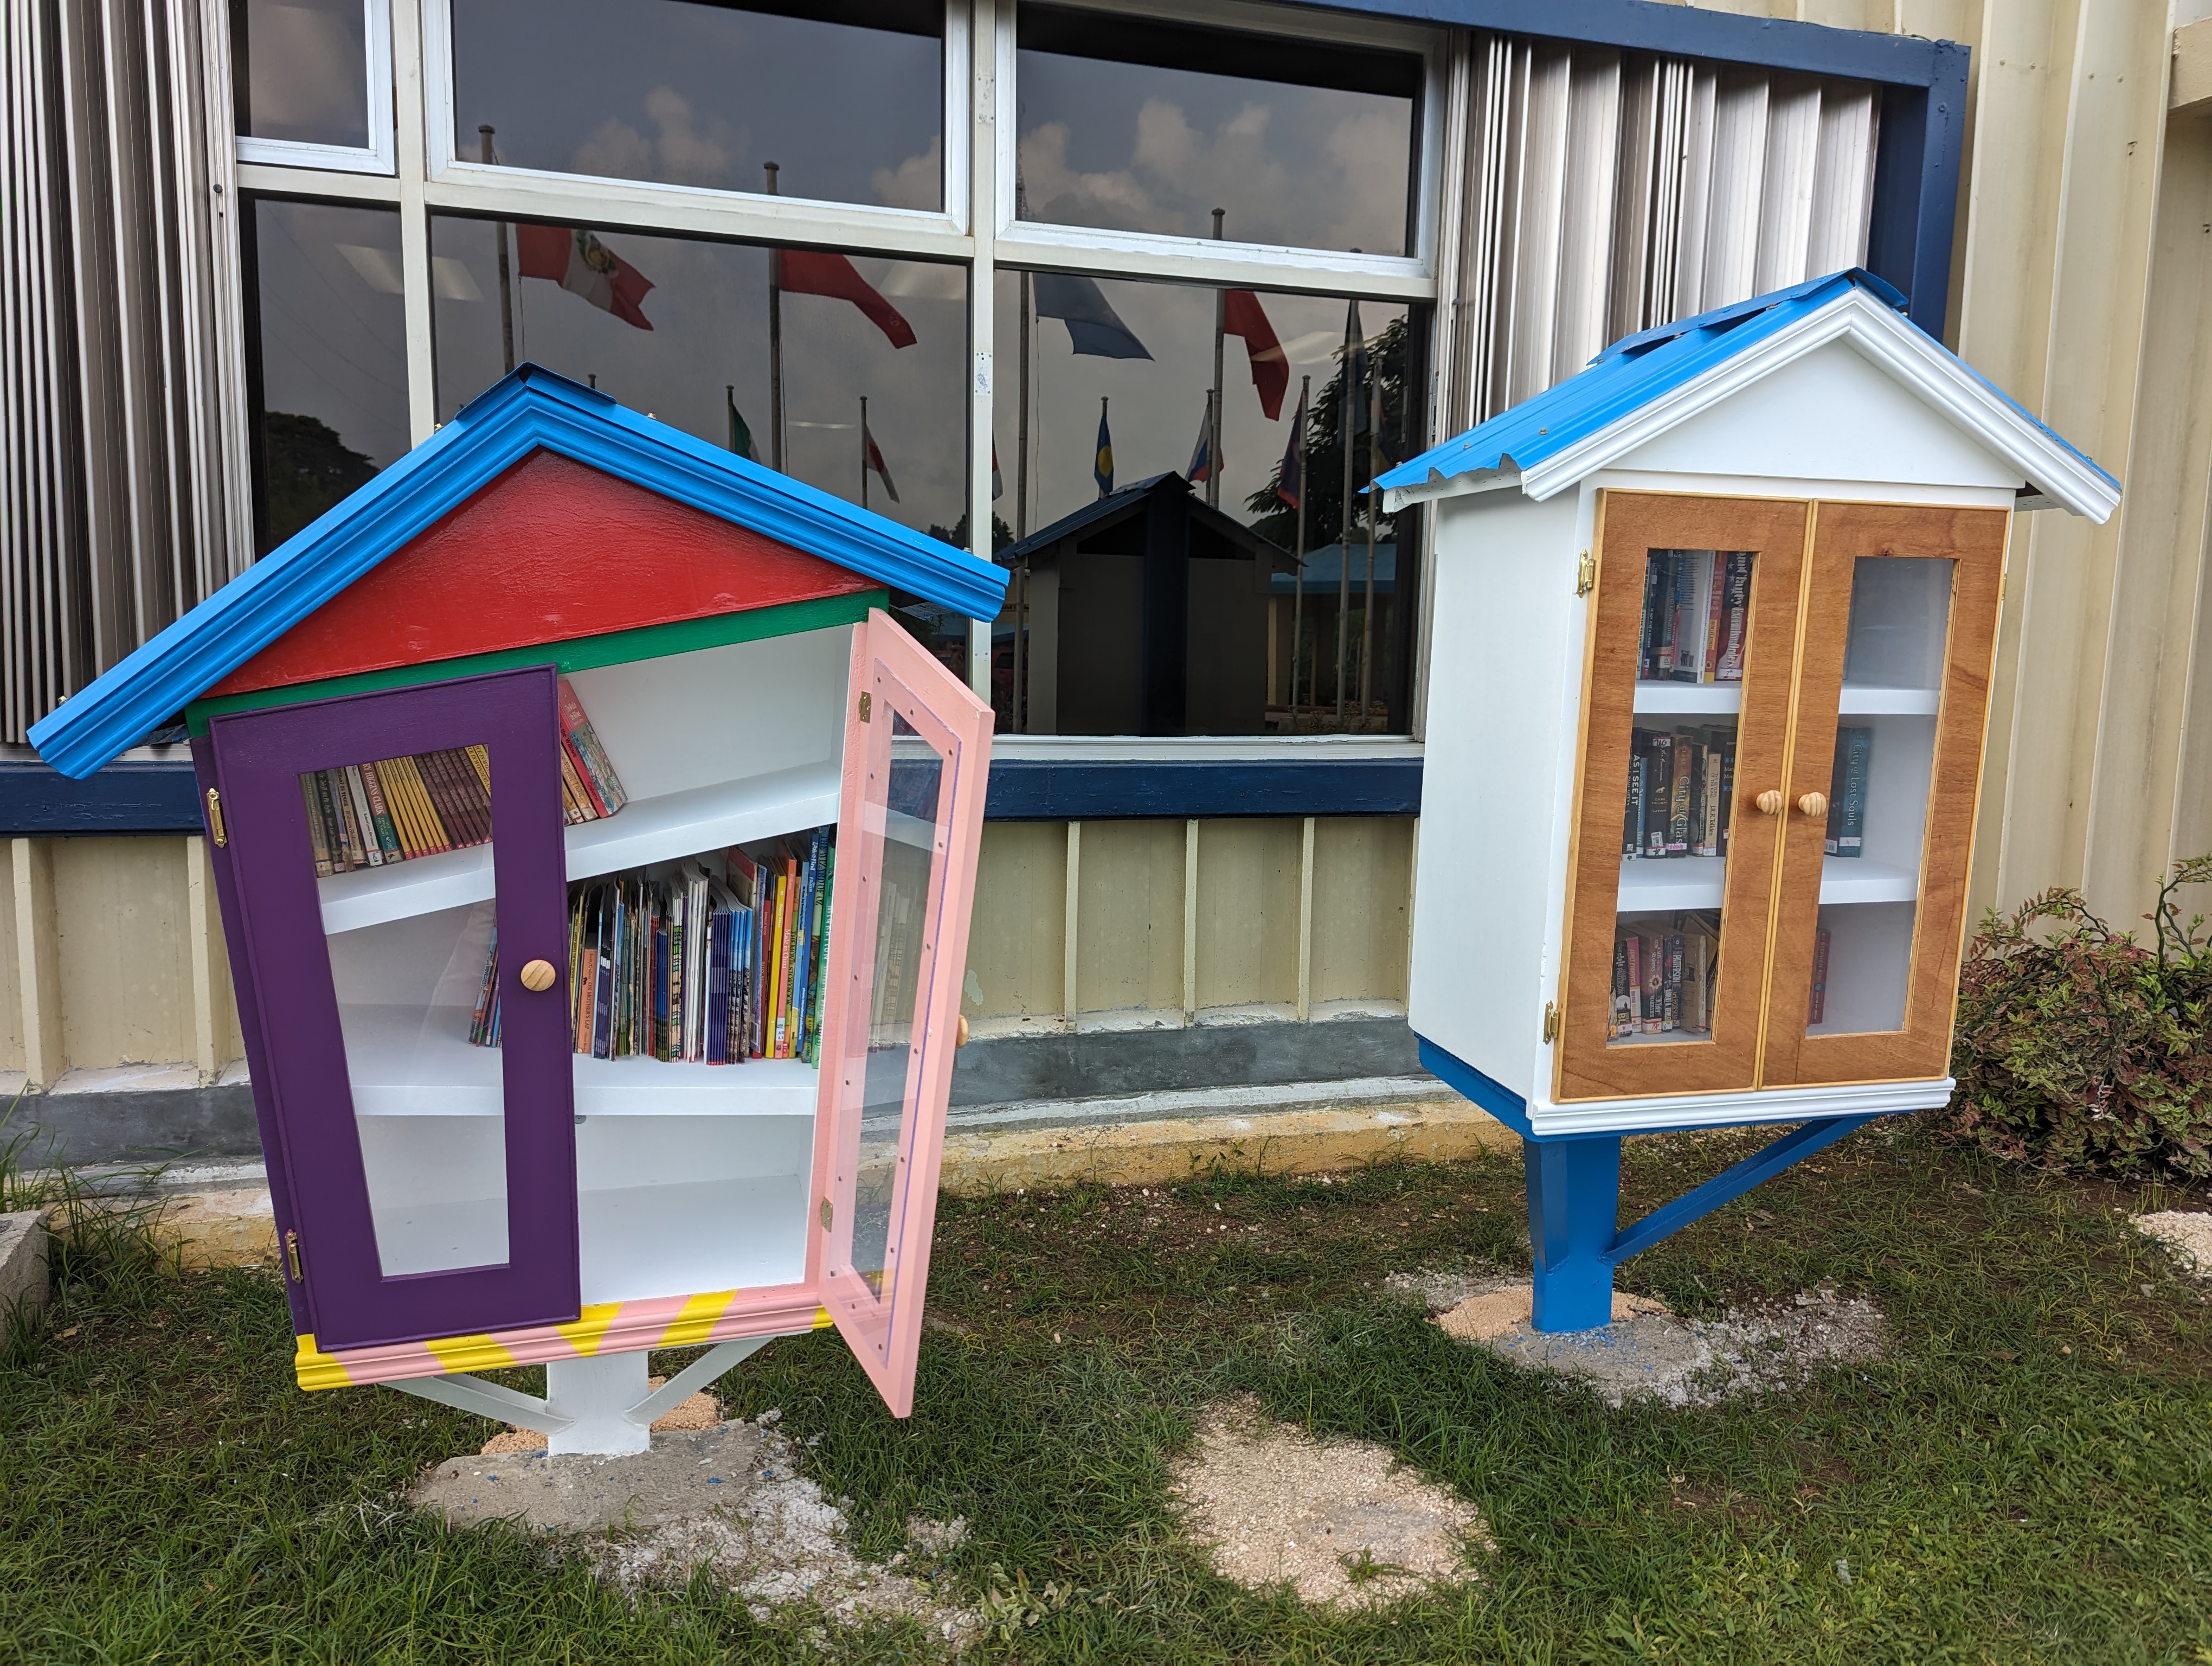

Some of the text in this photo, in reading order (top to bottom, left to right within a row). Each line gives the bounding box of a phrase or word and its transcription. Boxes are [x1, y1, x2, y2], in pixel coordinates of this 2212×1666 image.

[1731, 568, 1747, 609] Clancy
[1666, 606, 1674, 641] LIVINGSTONE
[1727, 608, 1744, 668] Executive Orders
[470, 753, 477, 761] IN
[565, 739, 577, 758] Willows
[1632, 754, 1640, 767] AS
[1850, 744, 1862, 764] City
[473, 759, 491, 790] WONDERLA
[1849, 777, 1859, 797] Lost
[362, 762, 385, 816] RY HIGGINS CLARK
[587, 781, 599, 801] Grahame
[1631, 797, 1638, 805] IT
[1674, 775, 1689, 844] City of Glas
[1847, 800, 1858, 826] Souls
[816, 835, 829, 906] THE WIZARD OF OZ
[1673, 954, 1681, 982] PATTERSON
[587, 982, 593, 991] ON
